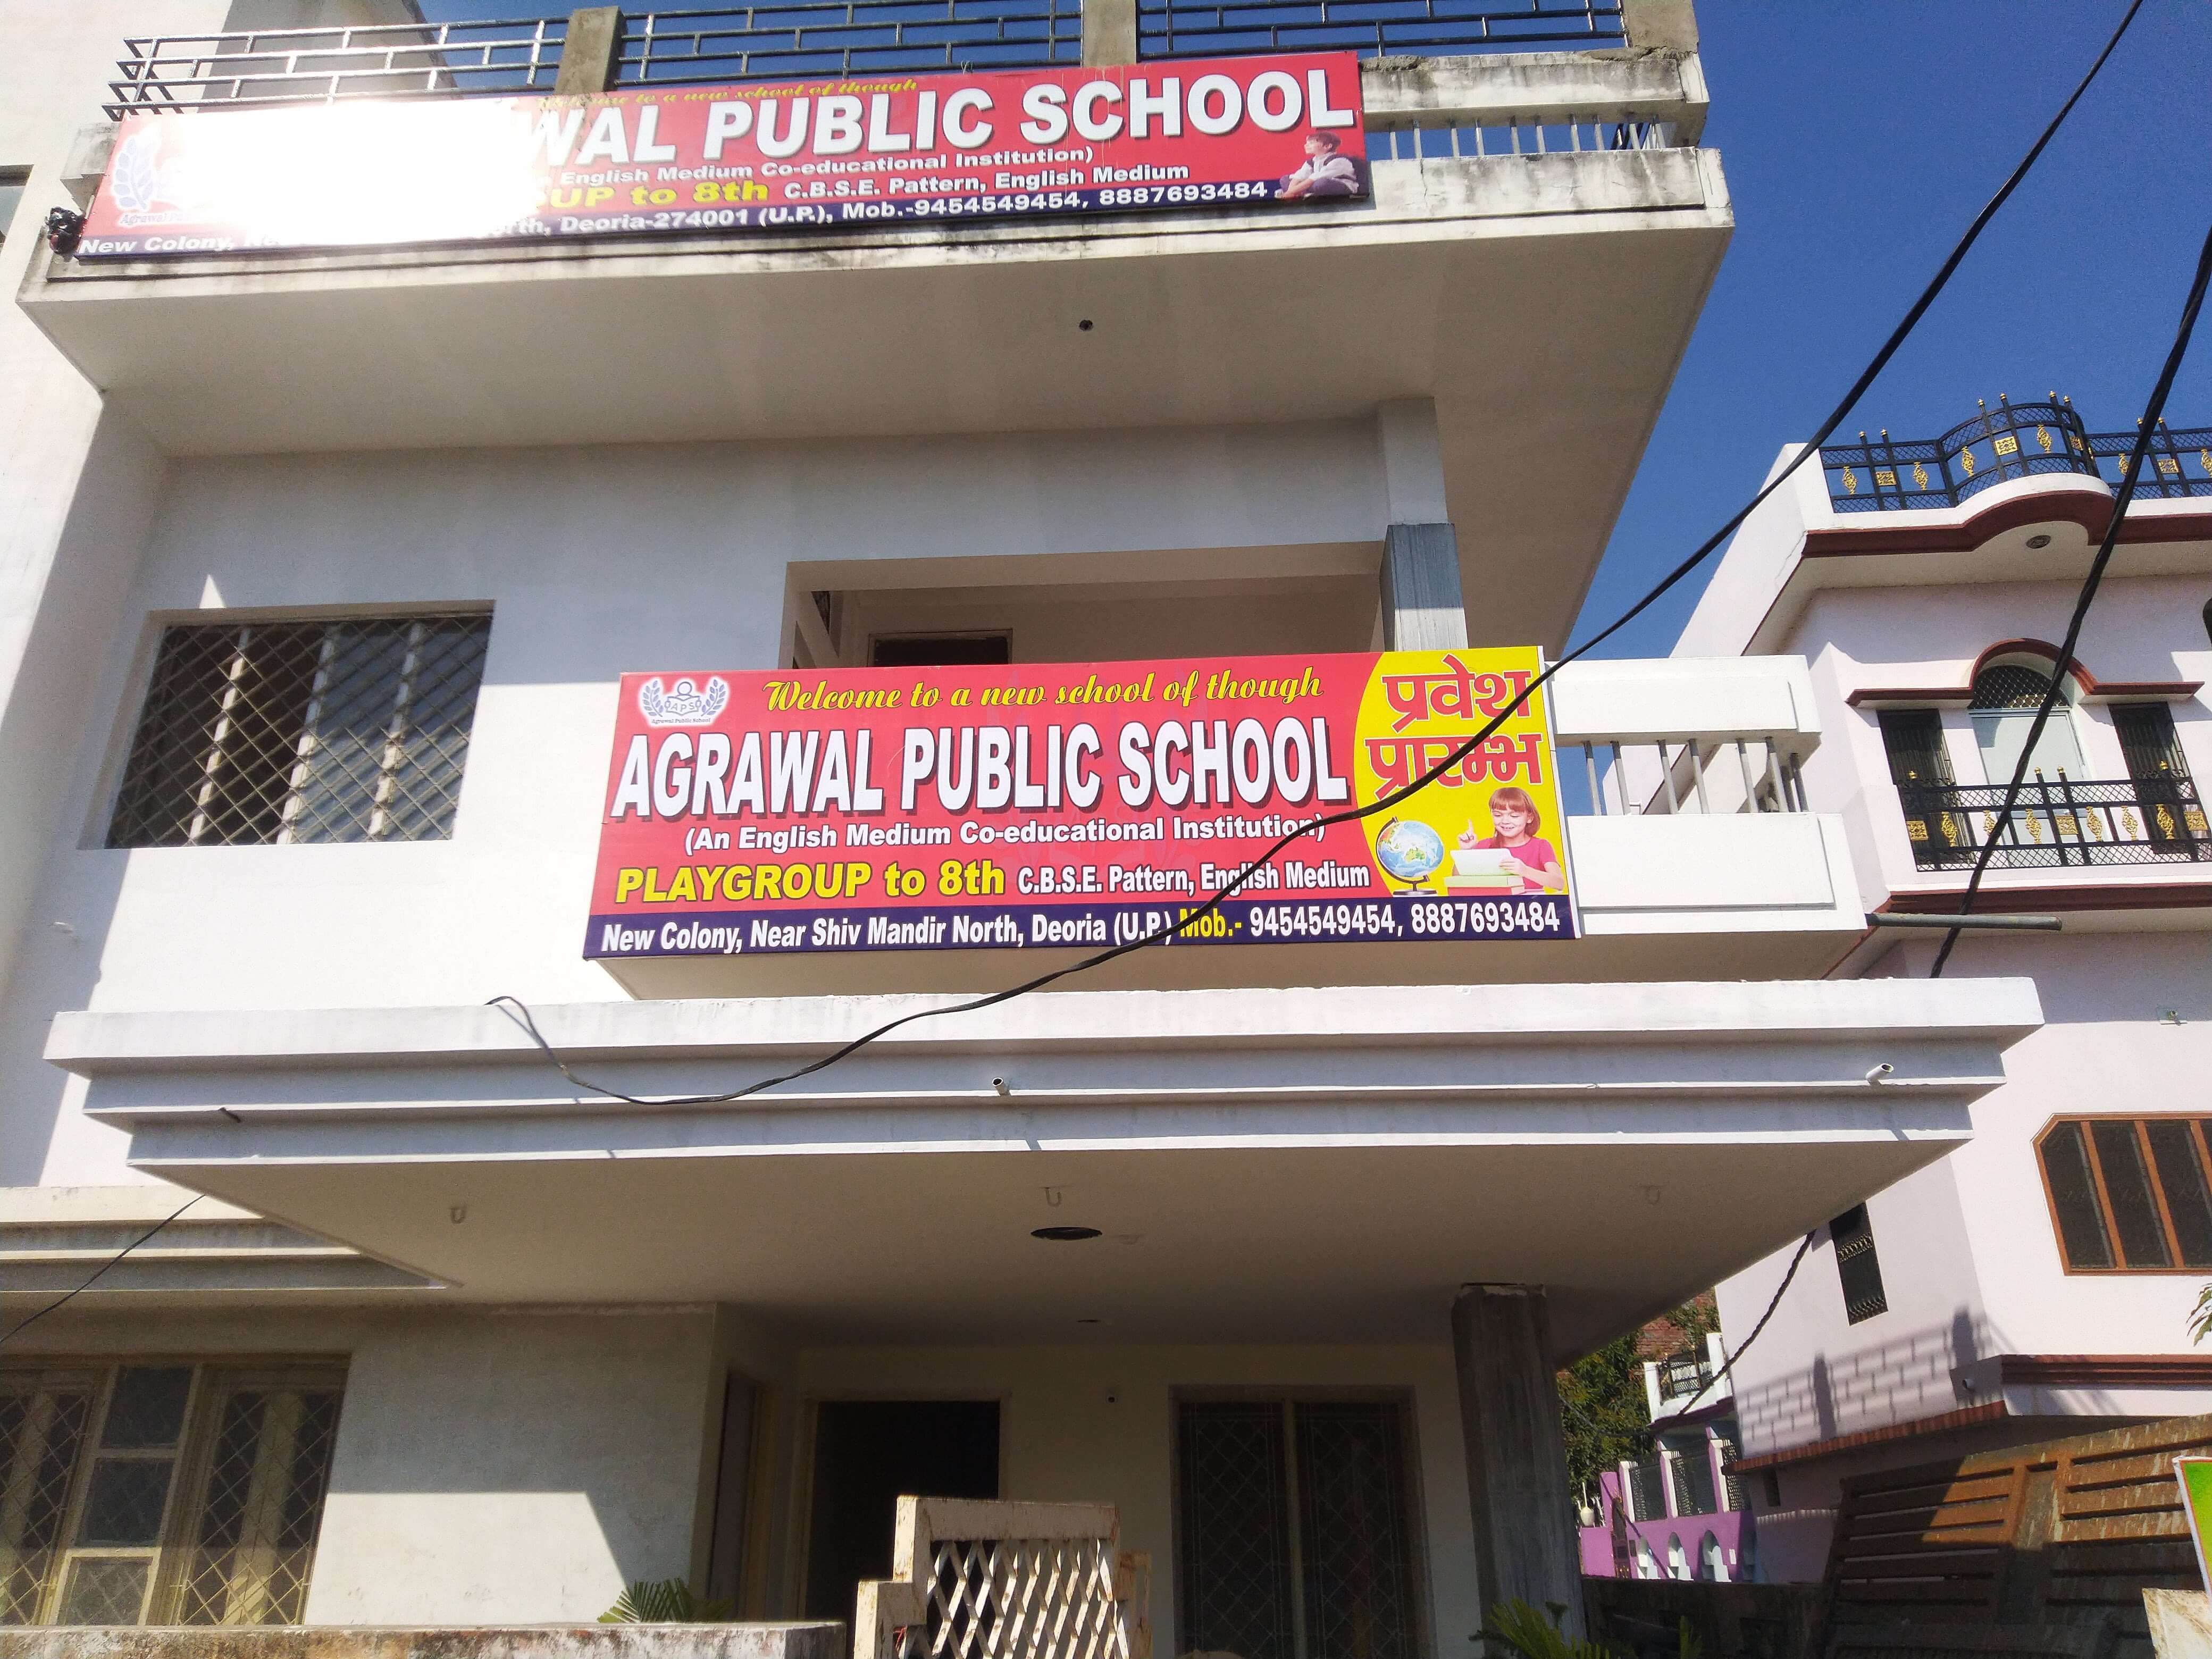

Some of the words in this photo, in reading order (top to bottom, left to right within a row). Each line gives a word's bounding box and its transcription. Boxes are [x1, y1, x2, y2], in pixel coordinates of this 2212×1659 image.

[702, 87, 993, 160] PUBLIC
[1020, 69, 1355, 145] SCHOOL
[560, 167, 649, 187] English
[657, 164, 753, 181] Medium
[761, 154, 946, 177] Co-educational
[956, 146, 1094, 167] Institution)
[630, 186, 677, 206] to
[693, 180, 769, 203] 8th
[784, 179, 881, 199] C.B.S.E.
[889, 175, 987, 194] Pattern,
[995, 168, 1085, 190] English
[1093, 164, 1189, 183] Medium
[79, 239, 137, 254] New
[144, 235, 236, 252] Colony,
[559, 209, 749, 232] Deoria-274001
[1099, 181, 1268, 205] 8887693484
[763, 680, 903, 711] Welcome
[910, 680, 941, 708] to
[950, 686, 974, 707] a
[981, 684, 1048, 706] new
[1054, 672, 1157, 705] school
[1163, 669, 1203, 708] of
[1206, 665, 1325, 705] though
[1380, 653, 1532, 733] प्रवेश
[610, 728, 886, 819] AGRAWAL
[900, 722, 1103, 813] PUBLIC
[1117, 716, 1348, 808] SCHOOL
[1364, 732, 1543, 801] प्रारम्भ
[684, 826, 731, 856] (An
[739, 825, 838, 855] English
[845, 822, 951, 847] Medium
[960, 815, 1166, 845] Co-educational
[1172, 813, 1325, 842] Institution)
[614, 861, 871, 904] PLAYGROUP
[884, 861, 926, 897] to
[937, 859, 1006, 896] 8th
[1017, 865, 1103, 894] C.B.S.E.
[1108, 862, 1195, 897] Pattern,
[1200, 861, 1279, 897] English
[1285, 859, 1370, 889] Medium
[601, 923, 656, 952] New
[660, 921, 742, 957] Colony,
[749, 918, 807, 947] Near
[811, 917, 861, 946] Shiv
[866, 915, 946, 945] Mandir
[952, 914, 1025, 948] North,
[1032, 913, 1107, 943] Deoria
[1250, 903, 1403, 939] 9454549454,
[1411, 901, 1561, 935] 8887693484
